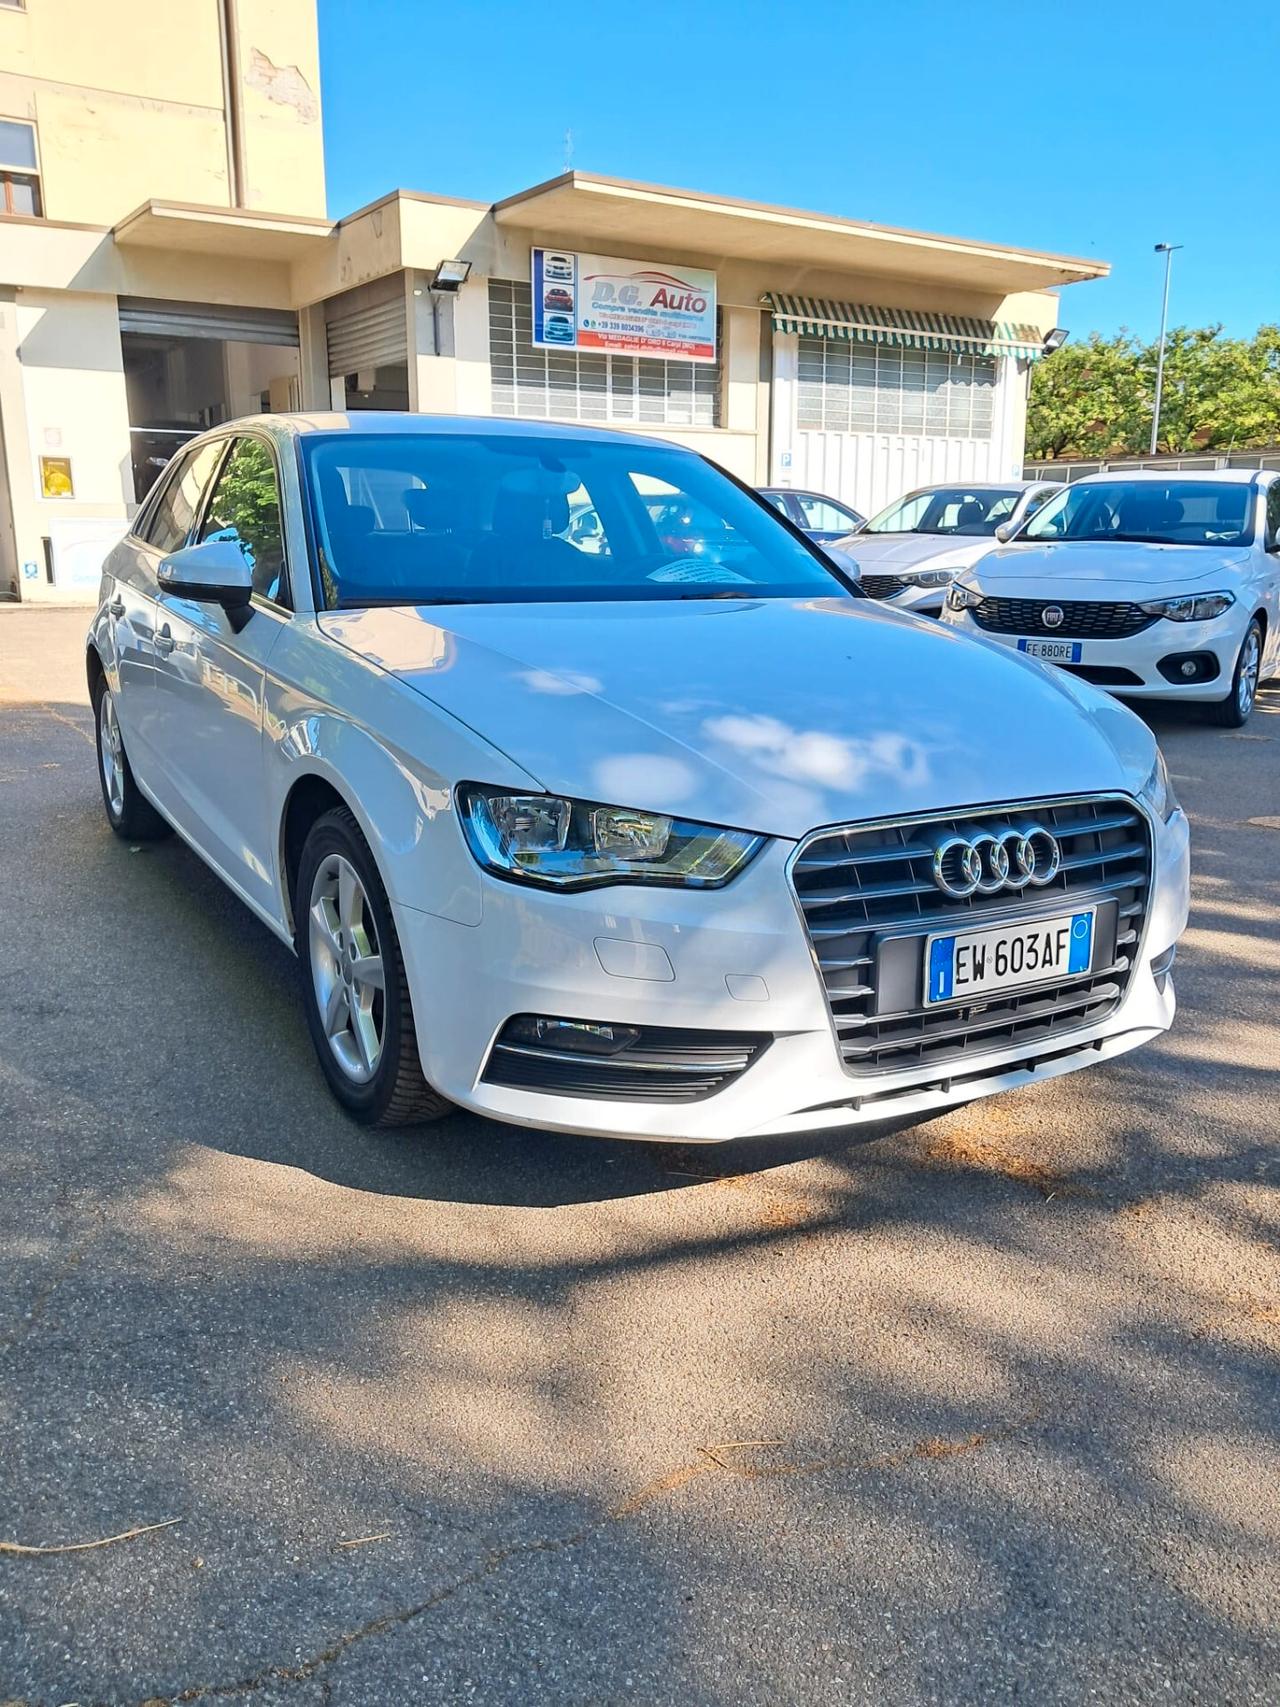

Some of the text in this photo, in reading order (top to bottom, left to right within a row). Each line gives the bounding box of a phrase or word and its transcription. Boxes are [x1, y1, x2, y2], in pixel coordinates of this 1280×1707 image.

[649, 287, 707, 313] Auto
[1041, 645, 1072, 658] 880RE
[956, 928, 1070, 985] EW 603AF
